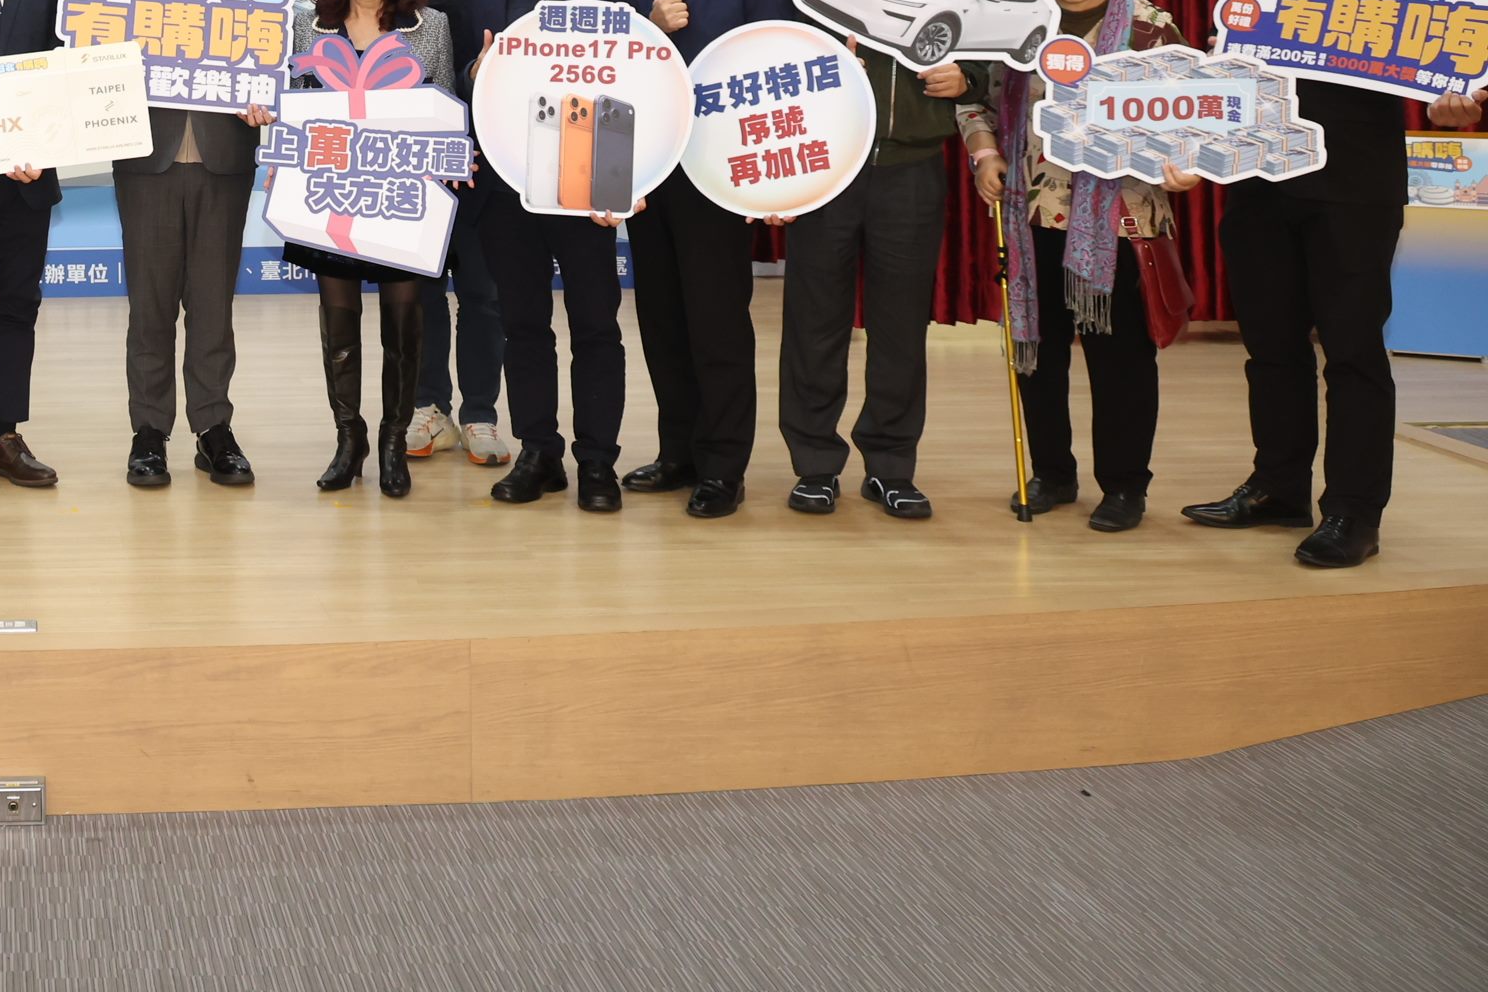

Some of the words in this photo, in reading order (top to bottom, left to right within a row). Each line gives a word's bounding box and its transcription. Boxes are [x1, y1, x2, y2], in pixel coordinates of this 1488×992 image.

[67, 0, 284, 66] 有購嗨
[539, 5, 631, 35] 週週抽
[92, 53, 127, 63] STARLUX
[498, 37, 618, 59] iPhone17
[628, 41, 672, 61] Pro
[1045, 54, 1085, 72] 獨得
[146, 64, 276, 107] 歡樂抽
[550, 64, 617, 84] 256G
[693, 53, 842, 118] 友好特店
[88, 84, 126, 95] TAIPEI
[85, 115, 138, 128] PHOENIX
[1098, 94, 1225, 122] 1000萬
[1226, 95, 1242, 122] 現金
[739, 105, 807, 146] 序號
[261, 124, 468, 175] 上萬份好禮
[728, 139, 831, 187] 再加倍
[312, 175, 421, 216] 大方送
[39, 263, 109, 285] 辦單位
